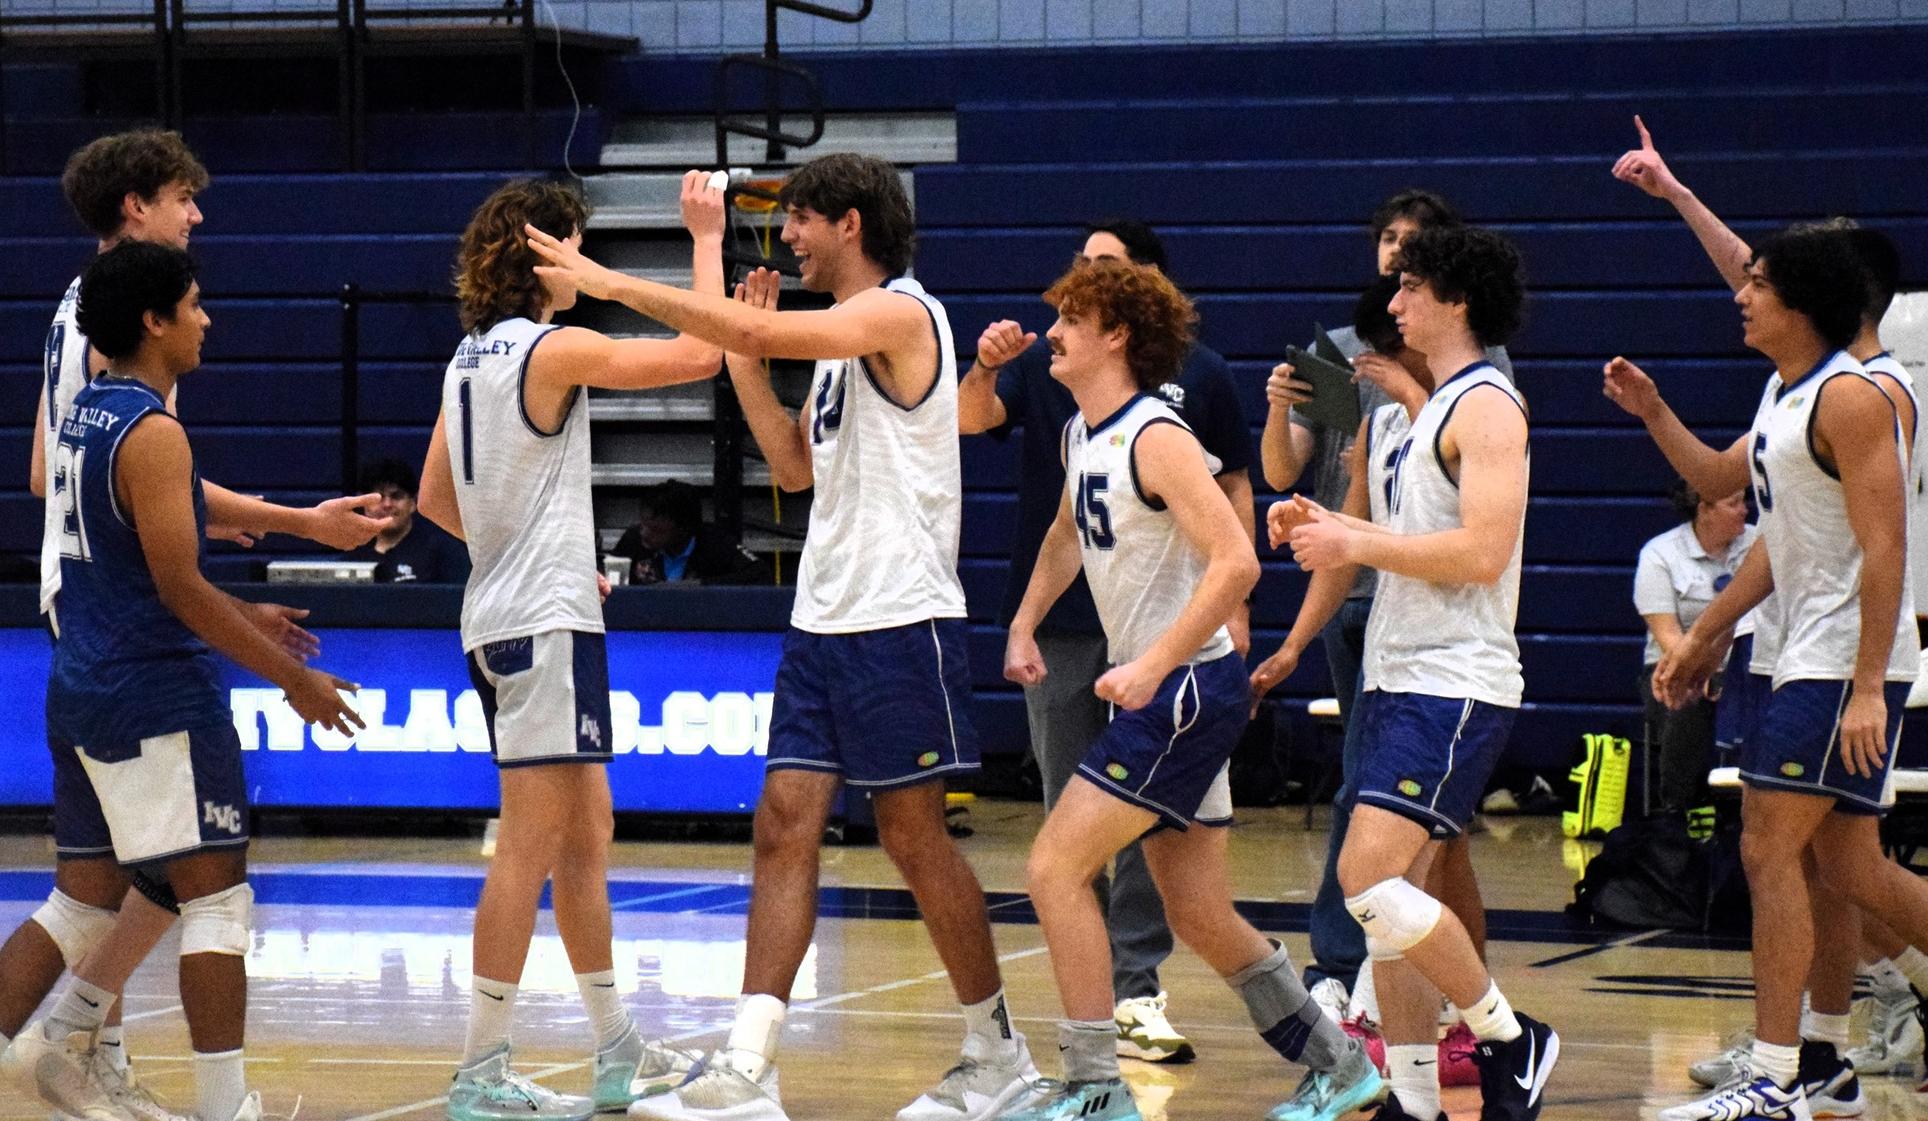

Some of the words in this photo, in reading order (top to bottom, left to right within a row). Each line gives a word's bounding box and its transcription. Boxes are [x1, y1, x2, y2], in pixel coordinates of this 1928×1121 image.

[459, 376, 475, 485] 1
[54, 442, 93, 563] 21
[1075, 470, 1117, 551] 45
[203, 800, 242, 835] IVC
